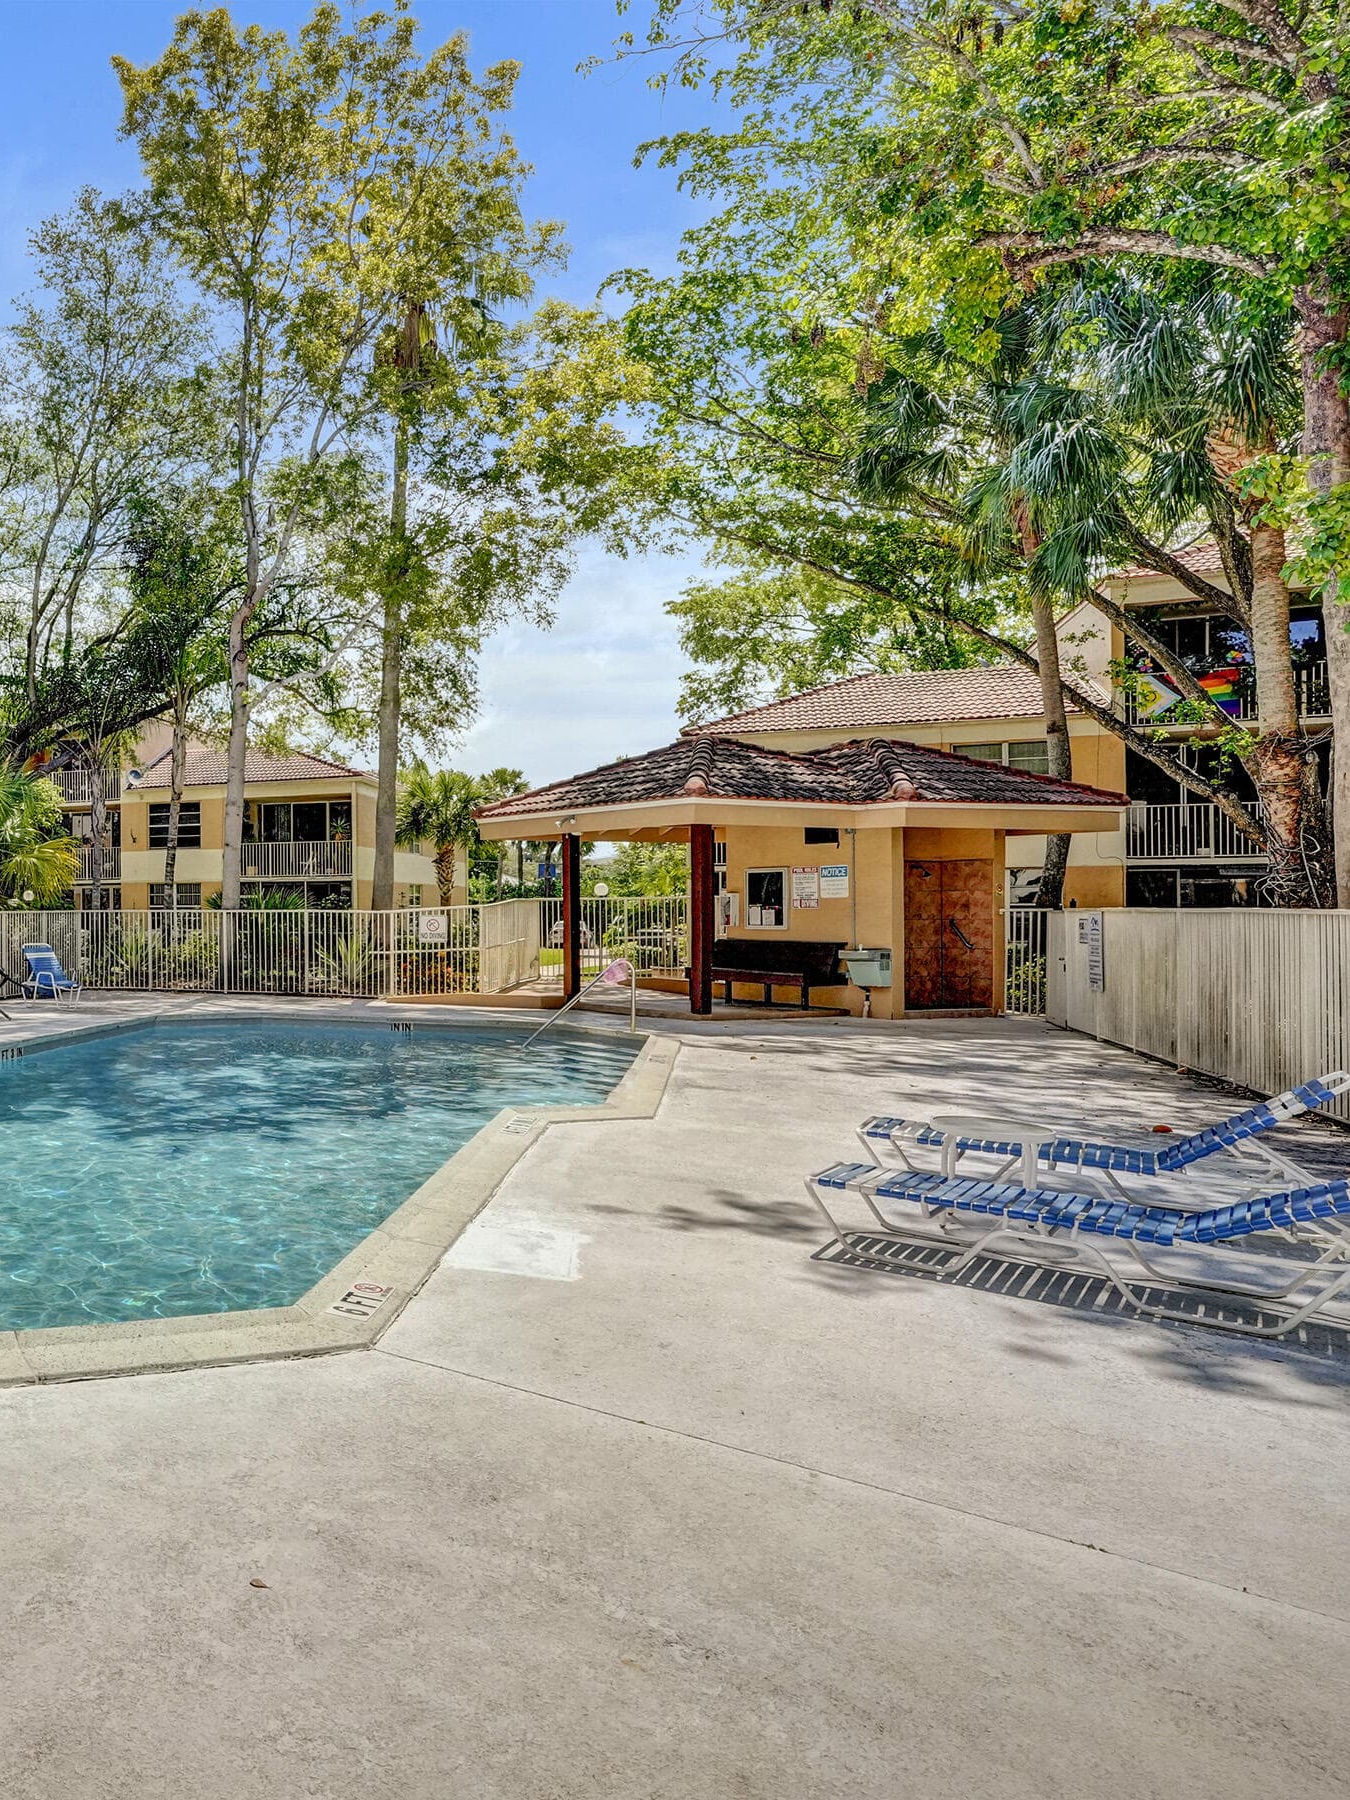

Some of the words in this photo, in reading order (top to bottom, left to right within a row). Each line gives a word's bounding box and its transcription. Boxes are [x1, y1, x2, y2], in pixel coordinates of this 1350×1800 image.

[821, 867, 848, 878] NOTICE
[1, 1049, 9, 1060] FT
[16, 1047, 23, 1057] IN
[340, 1291, 383, 1309] FT
[332, 1305, 370, 1317] 6
